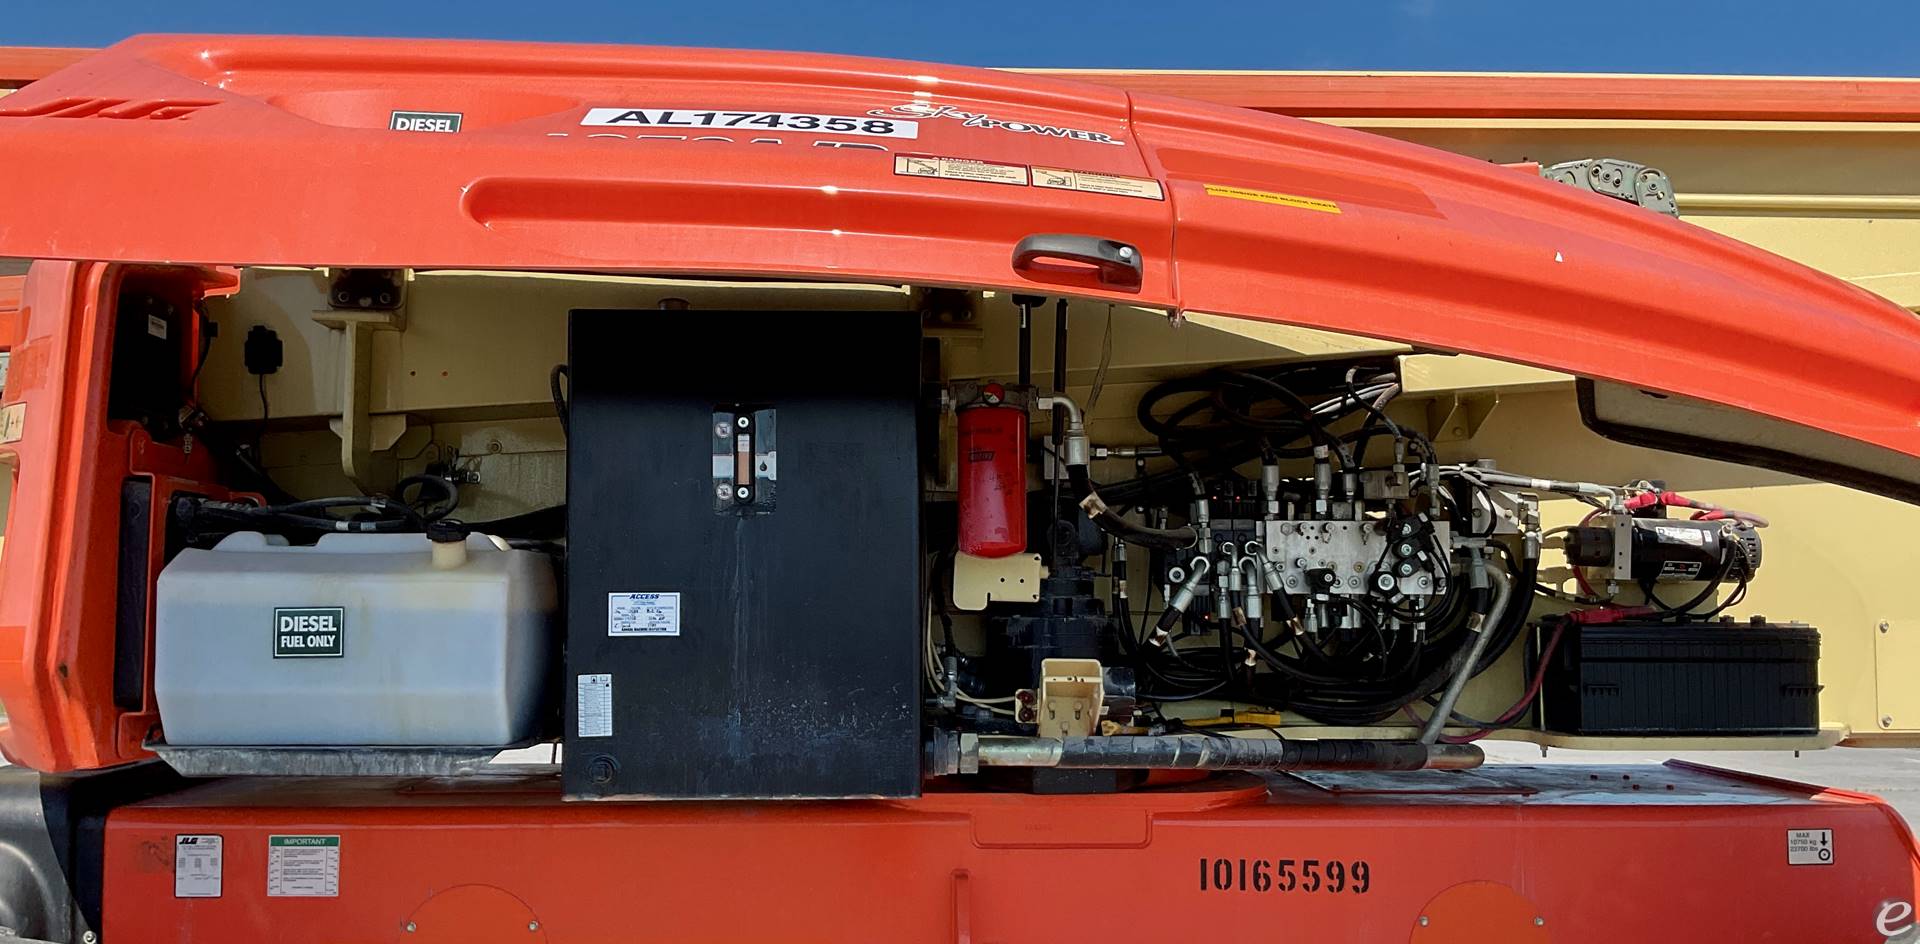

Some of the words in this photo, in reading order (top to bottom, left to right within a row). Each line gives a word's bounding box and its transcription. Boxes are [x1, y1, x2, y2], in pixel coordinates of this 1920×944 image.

[396, 117, 454, 133] DIESEL
[605, 110, 896, 135] AL174358
[280, 615, 337, 632] DIESEL
[281, 635, 305, 648] FUEL
[307, 634, 336, 648] ONLY
[179, 837, 198, 845] JLG
[283, 838, 326, 846] IMPORTANT
[1199, 858, 1370, 894] 10165599
